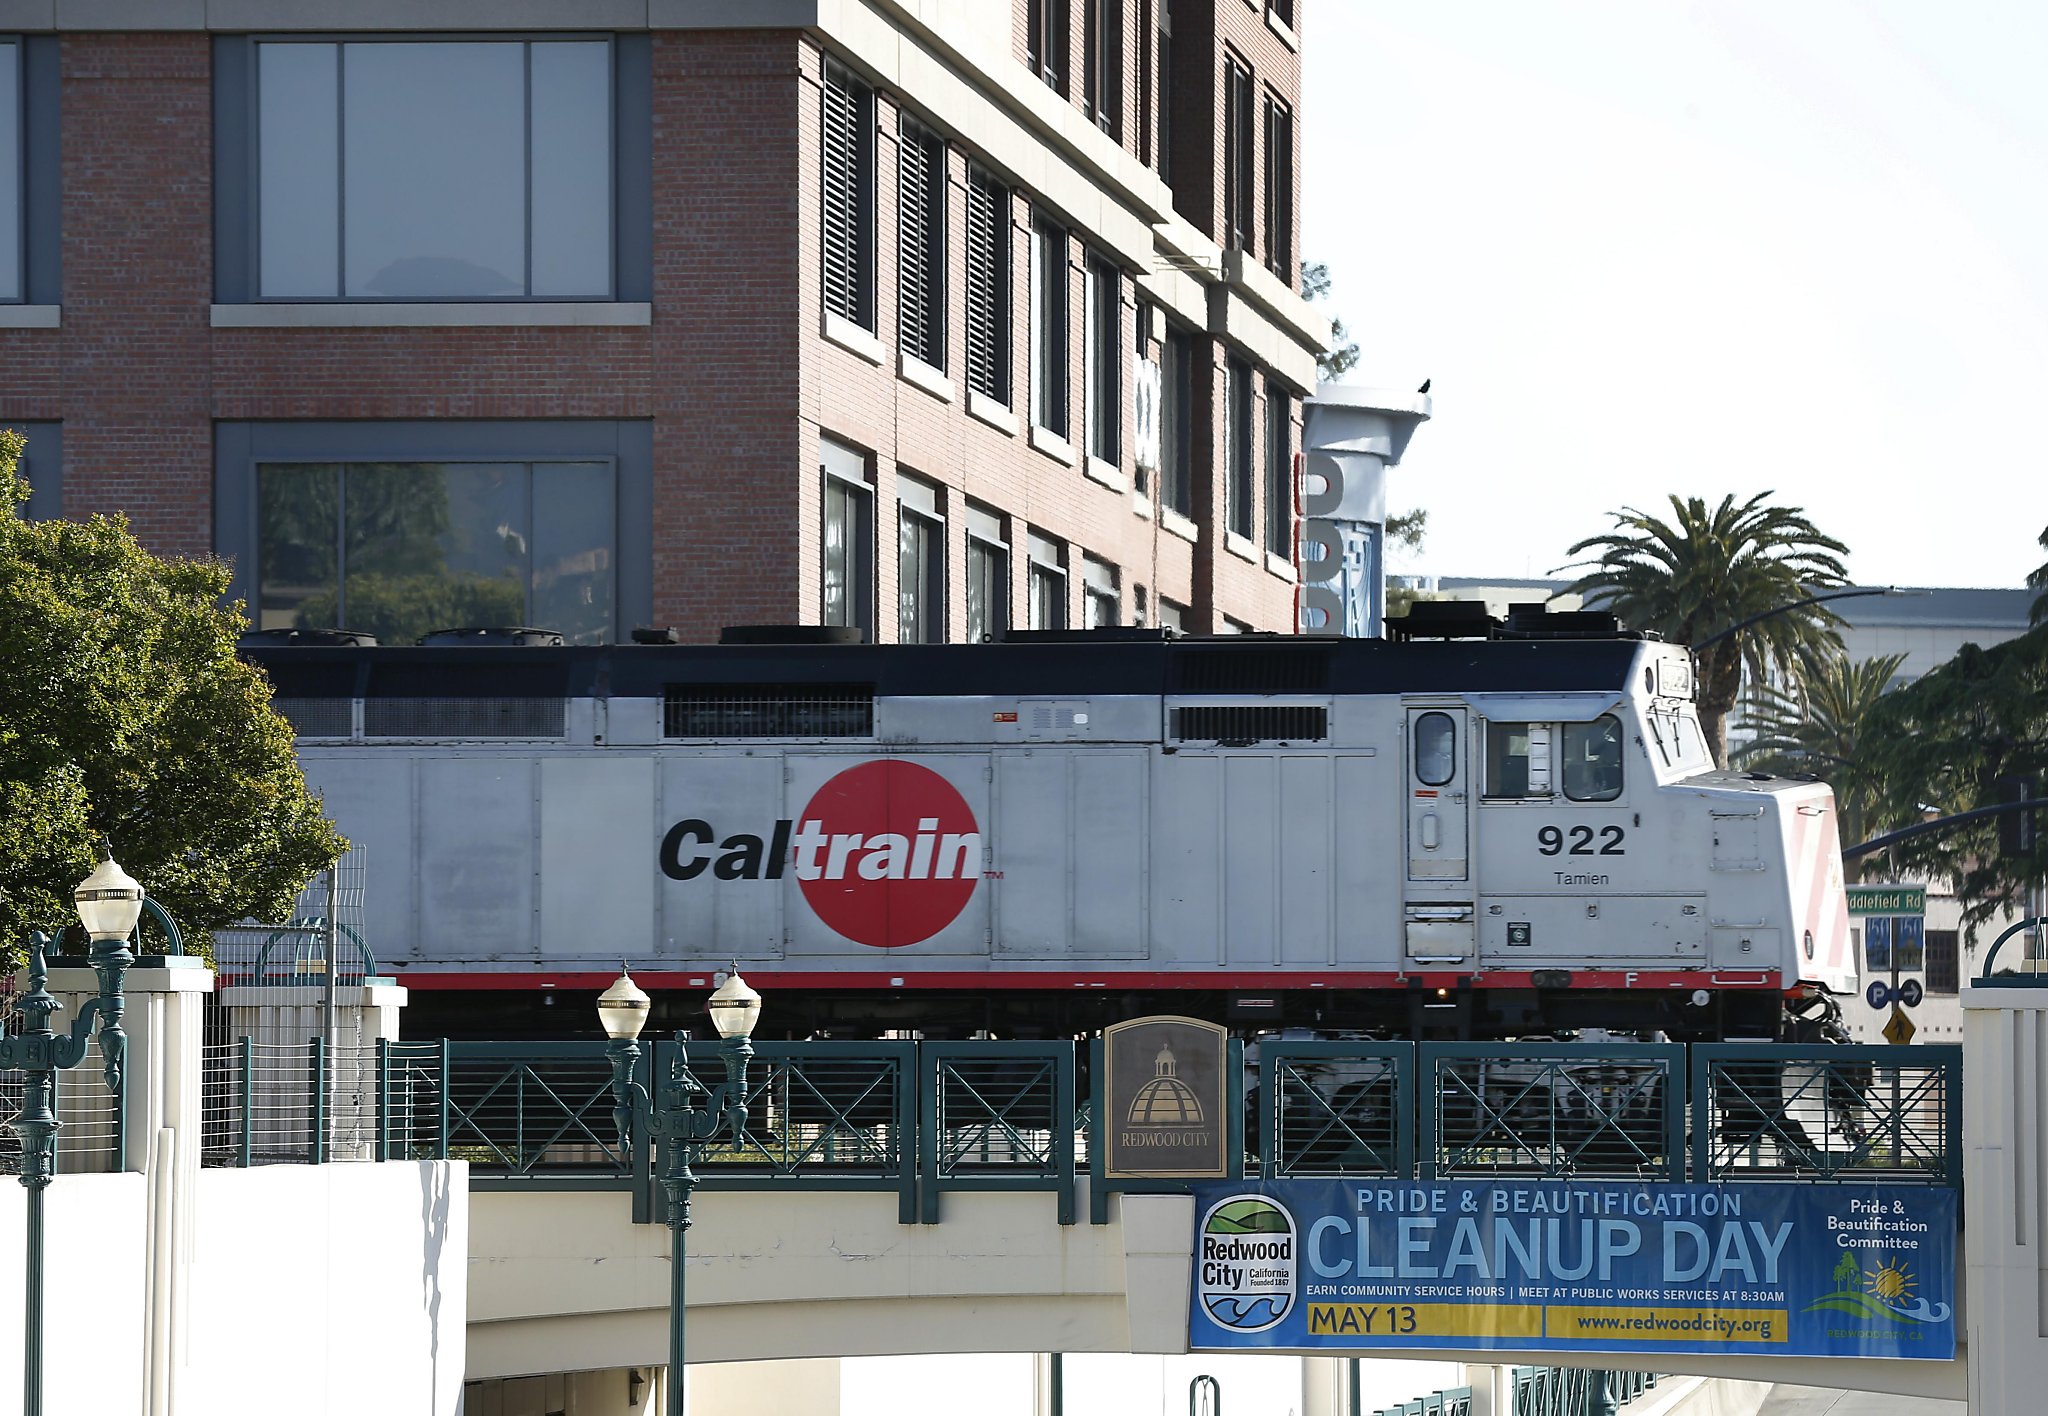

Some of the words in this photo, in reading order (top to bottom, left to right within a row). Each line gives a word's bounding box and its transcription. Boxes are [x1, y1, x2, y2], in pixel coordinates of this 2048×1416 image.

[659, 817, 981, 881] Caltrain
[1537, 825, 1626, 856] 922
[1554, 871, 1610, 886] Tamien
[1846, 894, 1900, 909] iddlefield
[1906, 894, 1922, 909] Rd
[1625, 972, 1639, 988] F
[1872, 987, 1886, 1002] P
[1121, 1132, 1181, 1147] REDWOOD
[1182, 1132, 1210, 1147] CITY
[1356, 1189, 1447, 1213] PRIDE
[1460, 1190, 1479, 1213] &
[1492, 1190, 1742, 1217] BEAUTIFICATION
[1851, 1200, 1889, 1214] Pride
[1892, 1200, 1905, 1215] &
[1827, 1216, 1928, 1233] Beautification
[1203, 1237, 1292, 1261] Redwood
[1307, 1215, 1642, 1281] CLEANUP
[1662, 1220, 1795, 1284] DAY
[1836, 1234, 1919, 1250] Committee
[1202, 1261, 1243, 1291] City
[1249, 1268, 1289, 1279] California
[1306, 1285, 1337, 1296] EARN
[1340, 1285, 1411, 1297] COMMUNITY
[1414, 1286, 1463, 1297] SERVICE
[1466, 1286, 1505, 1297] HOURS
[1518, 1286, 1550, 1298] MEET
[1552, 1287, 1568, 1298] AT
[1571, 1288, 1613, 1299] PUBLIC
[1617, 1288, 1660, 1300] WORKS
[1663, 1289, 1719, 1300] SERVICES
[1722, 1291, 1737, 1301] AT
[1740, 1291, 1785, 1302] 8:30AM
[1311, 1306, 1378, 1333] MAY
[1386, 1306, 1417, 1333] 13
[1577, 1312, 1772, 1339] www.redwoodcity.org
[1827, 1329, 1881, 1339] REDWOOD
[1909, 1331, 1924, 1341] CA
